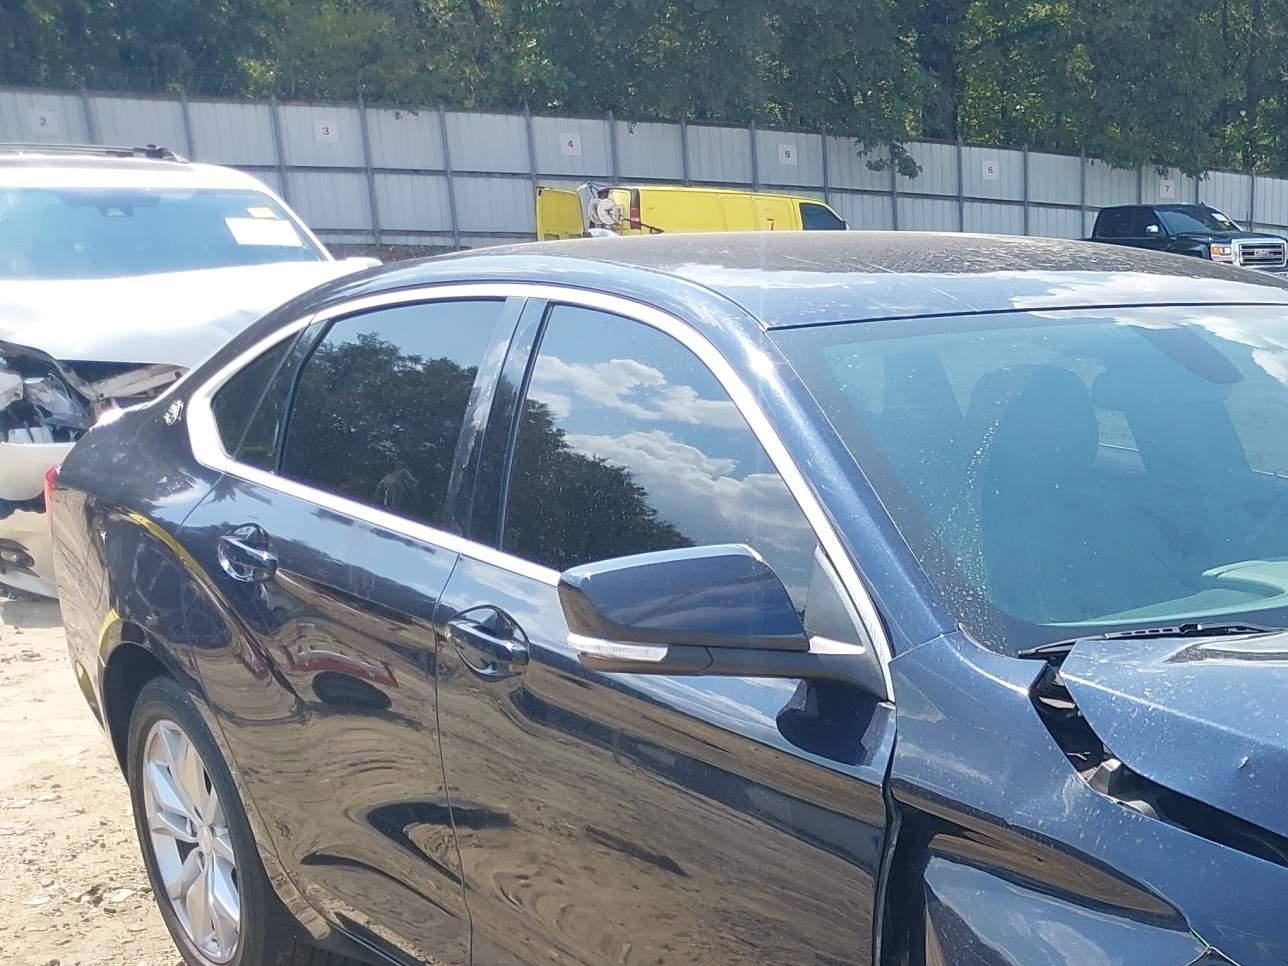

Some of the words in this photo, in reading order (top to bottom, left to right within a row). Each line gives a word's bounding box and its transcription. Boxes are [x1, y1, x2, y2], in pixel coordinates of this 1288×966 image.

[322, 126, 330, 136] 3
[567, 139, 575, 148] 4
[784, 150, 792, 159] 5
[987, 166, 995, 174] 6
